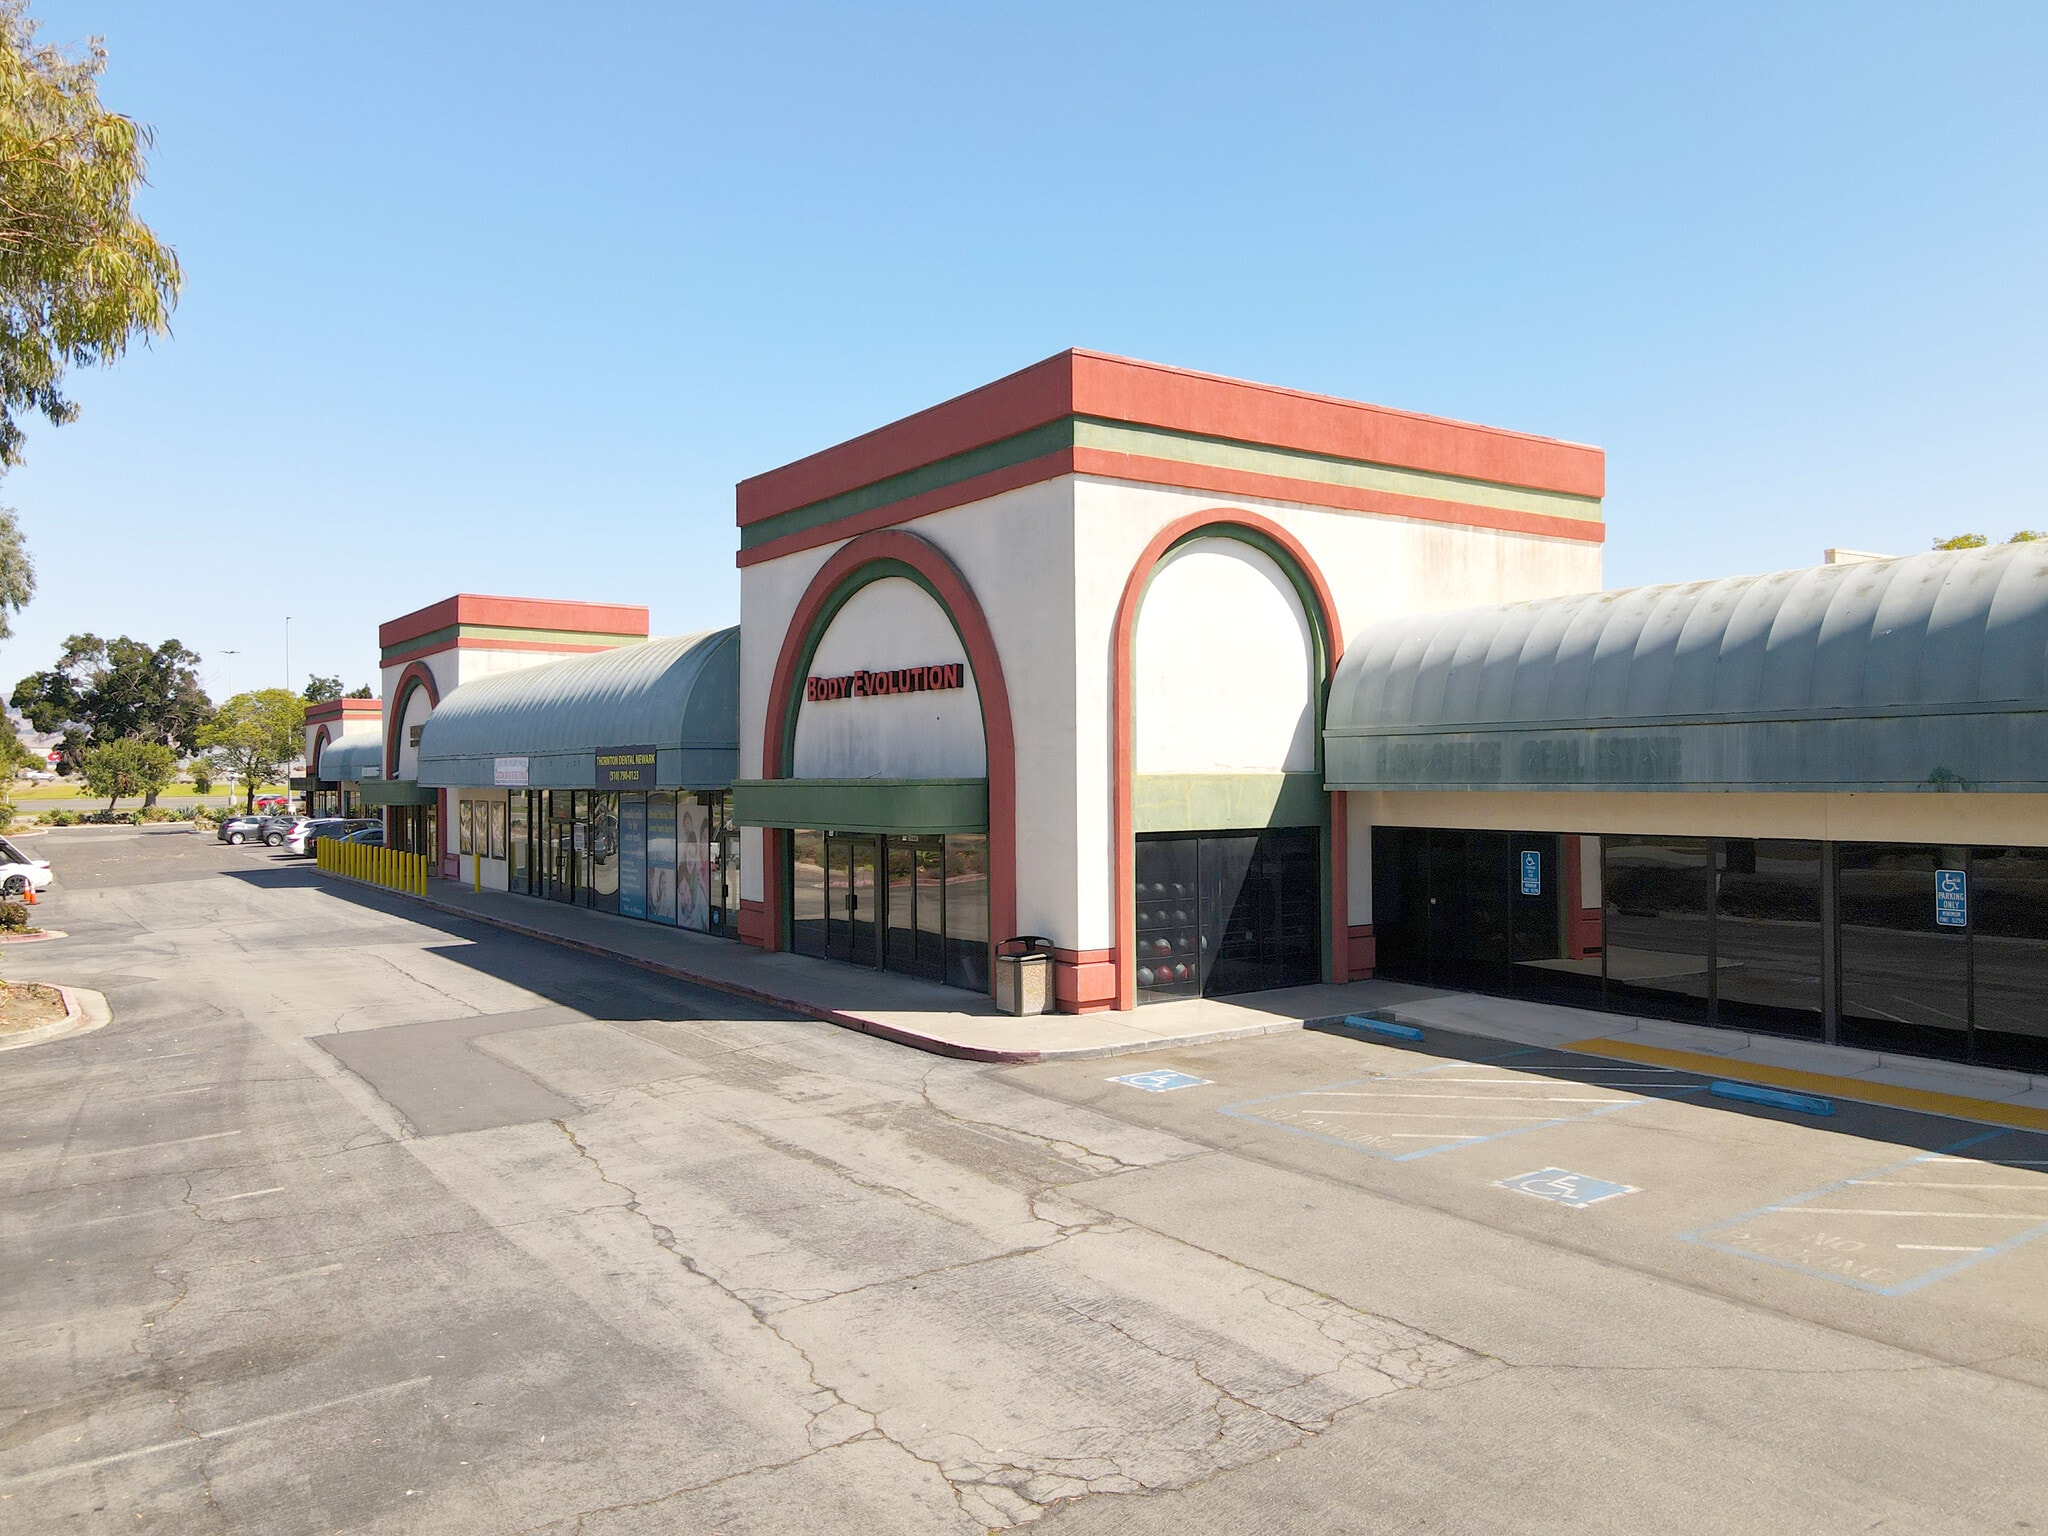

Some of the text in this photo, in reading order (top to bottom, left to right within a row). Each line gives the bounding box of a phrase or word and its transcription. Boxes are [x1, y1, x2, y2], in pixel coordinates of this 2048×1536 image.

[808, 663, 963, 702] BODY EVOLUTION
[619, 755, 635, 765] DENTAL
[1938, 892, 1964, 901] PARKING
[1943, 900, 1960, 909] ONLY
